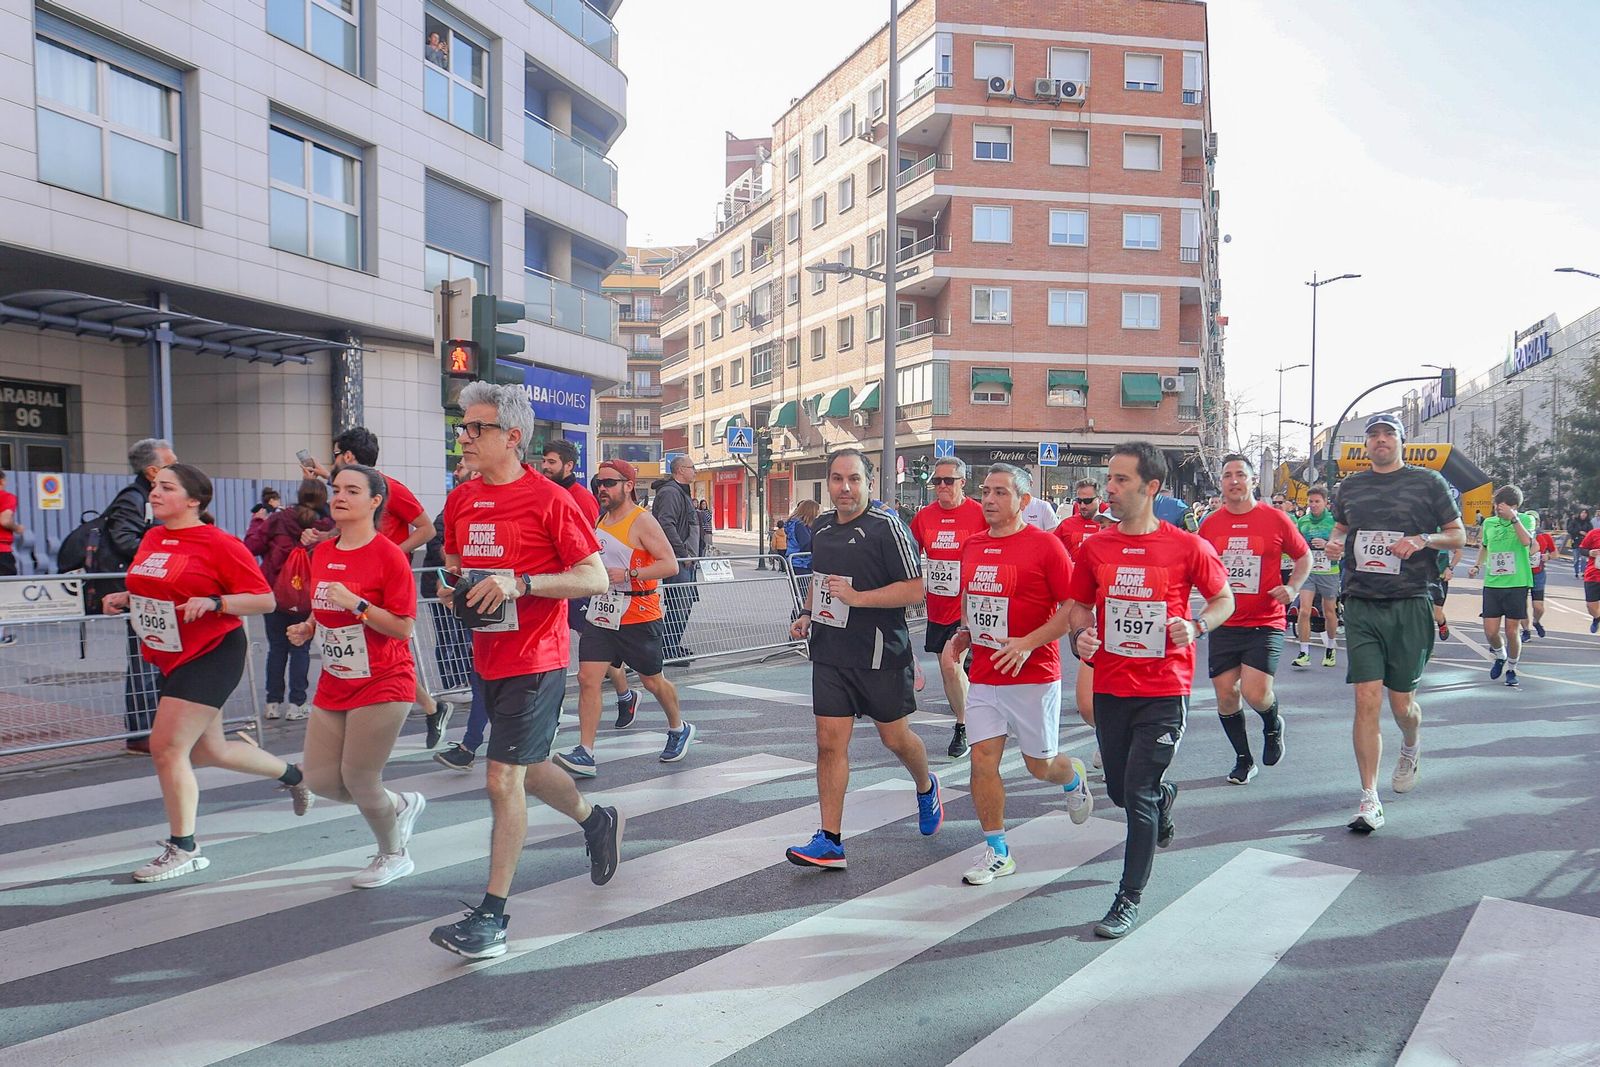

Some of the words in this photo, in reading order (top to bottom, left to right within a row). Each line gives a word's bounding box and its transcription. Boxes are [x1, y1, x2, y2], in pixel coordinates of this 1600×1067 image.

[16, 407, 42, 427] 96
[990, 450, 1026, 461] Puerta
[468, 523, 496, 531] MEMORIAL
[469, 531, 496, 545] PADRE
[462, 544, 505, 558] MARCELINO
[930, 571, 953, 581] 2924
[973, 571, 998, 583] PADRE
[1115, 574, 1146, 587] PADRE
[968, 582, 1003, 593] MARCELINO
[1108, 585, 1153, 599] MARCELINO
[594, 601, 615, 614] 1360
[139, 614, 167, 630] 1908
[973, 612, 999, 628] 1587
[1114, 618, 1154, 635] 1597
[321, 643, 355, 659] 1904
